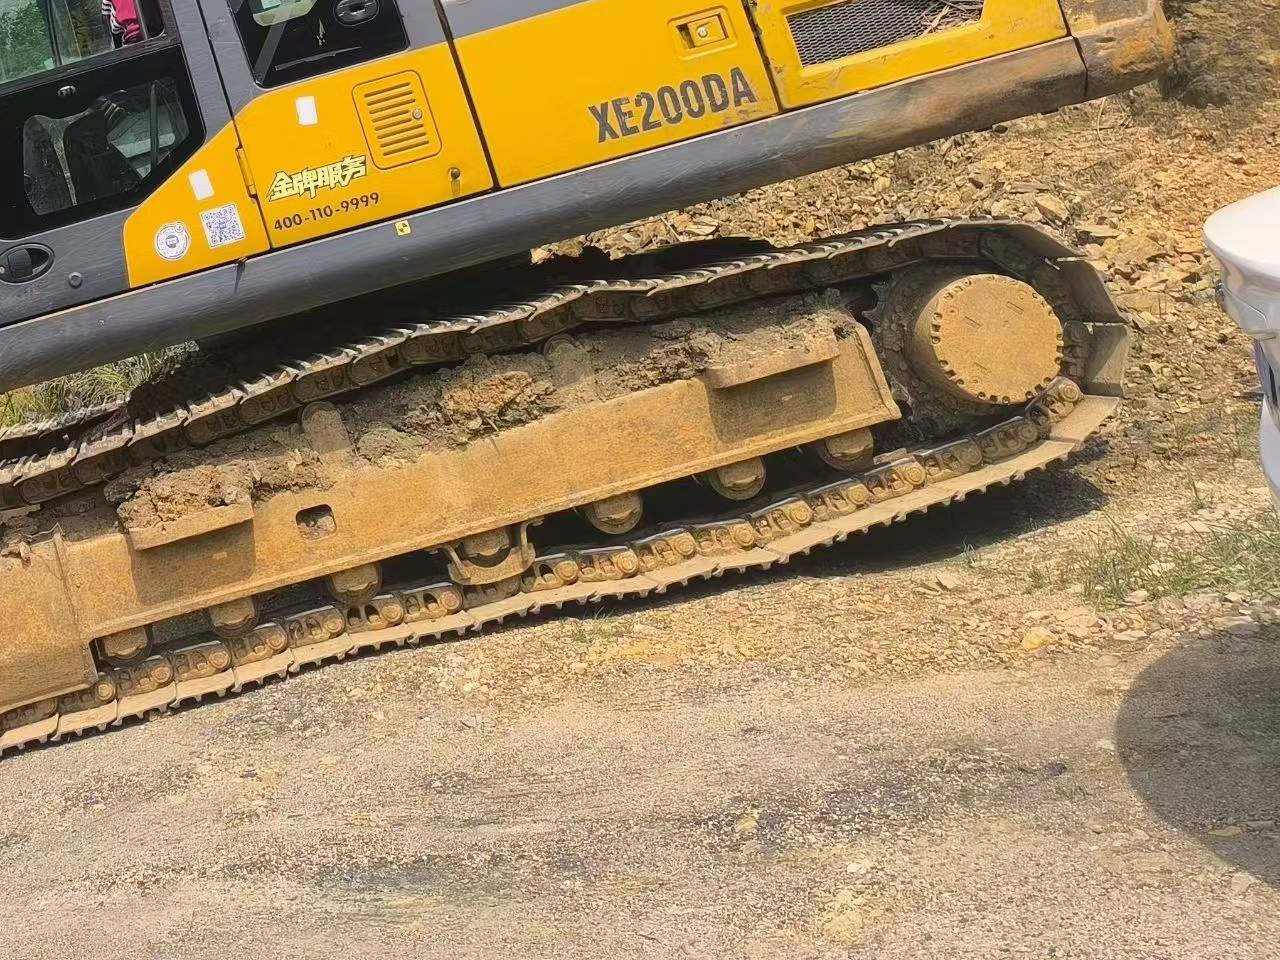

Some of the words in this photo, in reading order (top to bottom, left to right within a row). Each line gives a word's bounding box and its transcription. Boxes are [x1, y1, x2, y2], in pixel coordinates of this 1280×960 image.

[588, 67, 757, 143] XE200DA
[265, 155, 367, 202] 金牌服务
[274, 192, 379, 230] 400-110-9999
